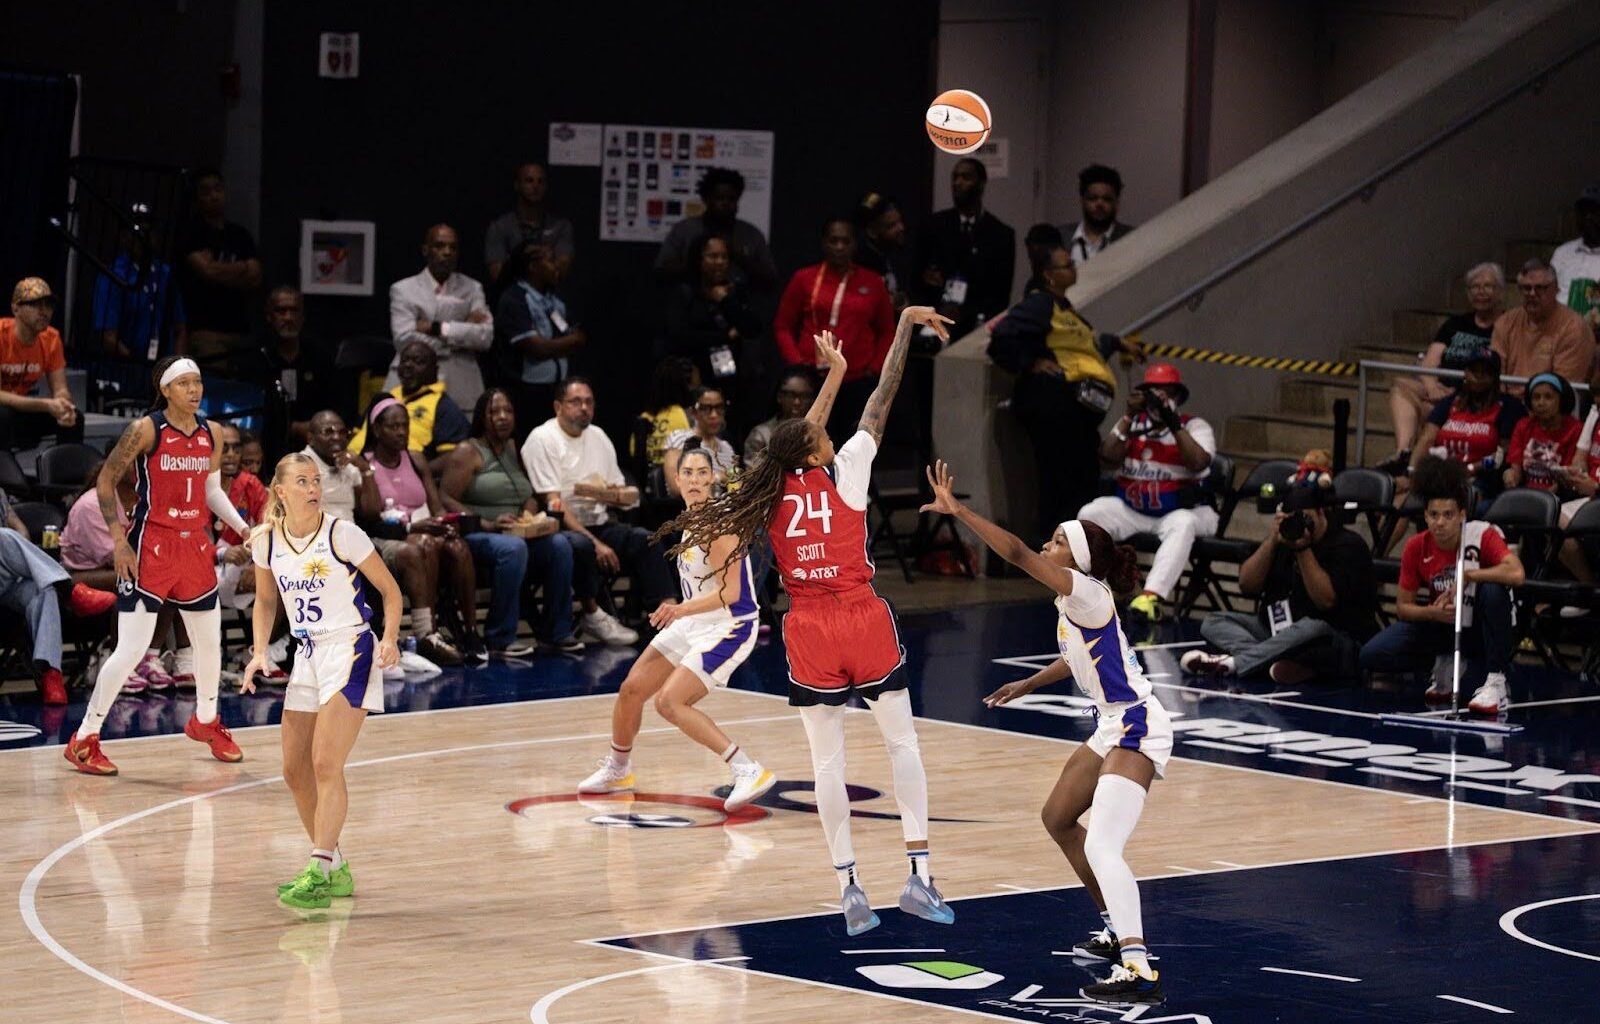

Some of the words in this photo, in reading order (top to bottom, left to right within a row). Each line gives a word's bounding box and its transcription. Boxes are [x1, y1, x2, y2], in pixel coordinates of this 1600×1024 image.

[186, 477, 193, 503] 1
[1124, 480, 1163, 510] 41
[782, 490, 833, 538] 24
[796, 542, 826, 562] SCOTT
[808, 565, 840, 580] AT&T
[294, 596, 323, 624] 35
